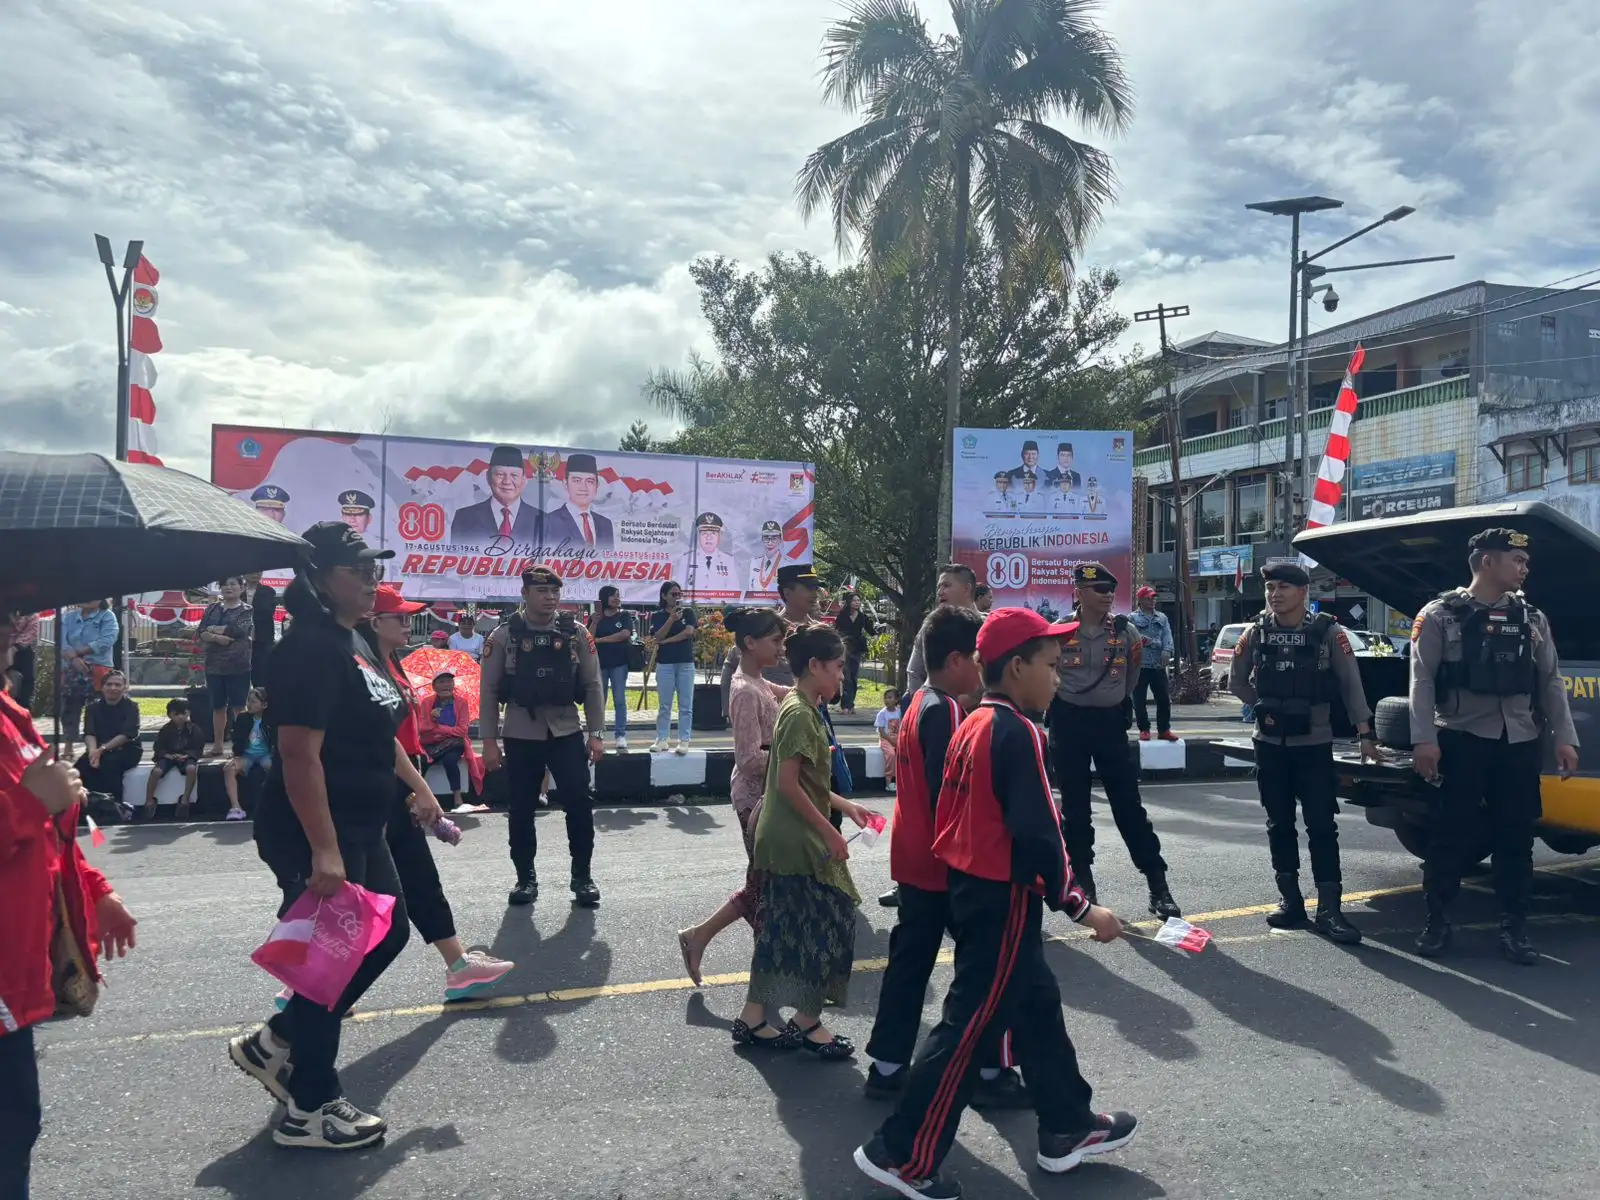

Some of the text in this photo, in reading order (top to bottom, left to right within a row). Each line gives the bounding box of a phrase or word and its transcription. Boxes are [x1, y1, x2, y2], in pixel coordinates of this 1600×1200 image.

[1362, 496, 1441, 517] FORCEUM
[398, 501, 445, 542] 80
[621, 528, 643, 537] Rakyat
[621, 535, 668, 545] Indonesia Maju
[980, 532, 1109, 550] REPUBLIK INDONESIA
[484, 534, 598, 571] Dirgahayu
[401, 554, 535, 578] REPUBLIK
[1031, 558, 1061, 566] Bersatu
[987, 552, 1029, 589] 80
[1031, 568, 1058, 577] Rakyat
[1031, 577, 1068, 585] Indonesia
[1501, 625, 1519, 633] POLISI
[1269, 634, 1304, 645] POLISI
